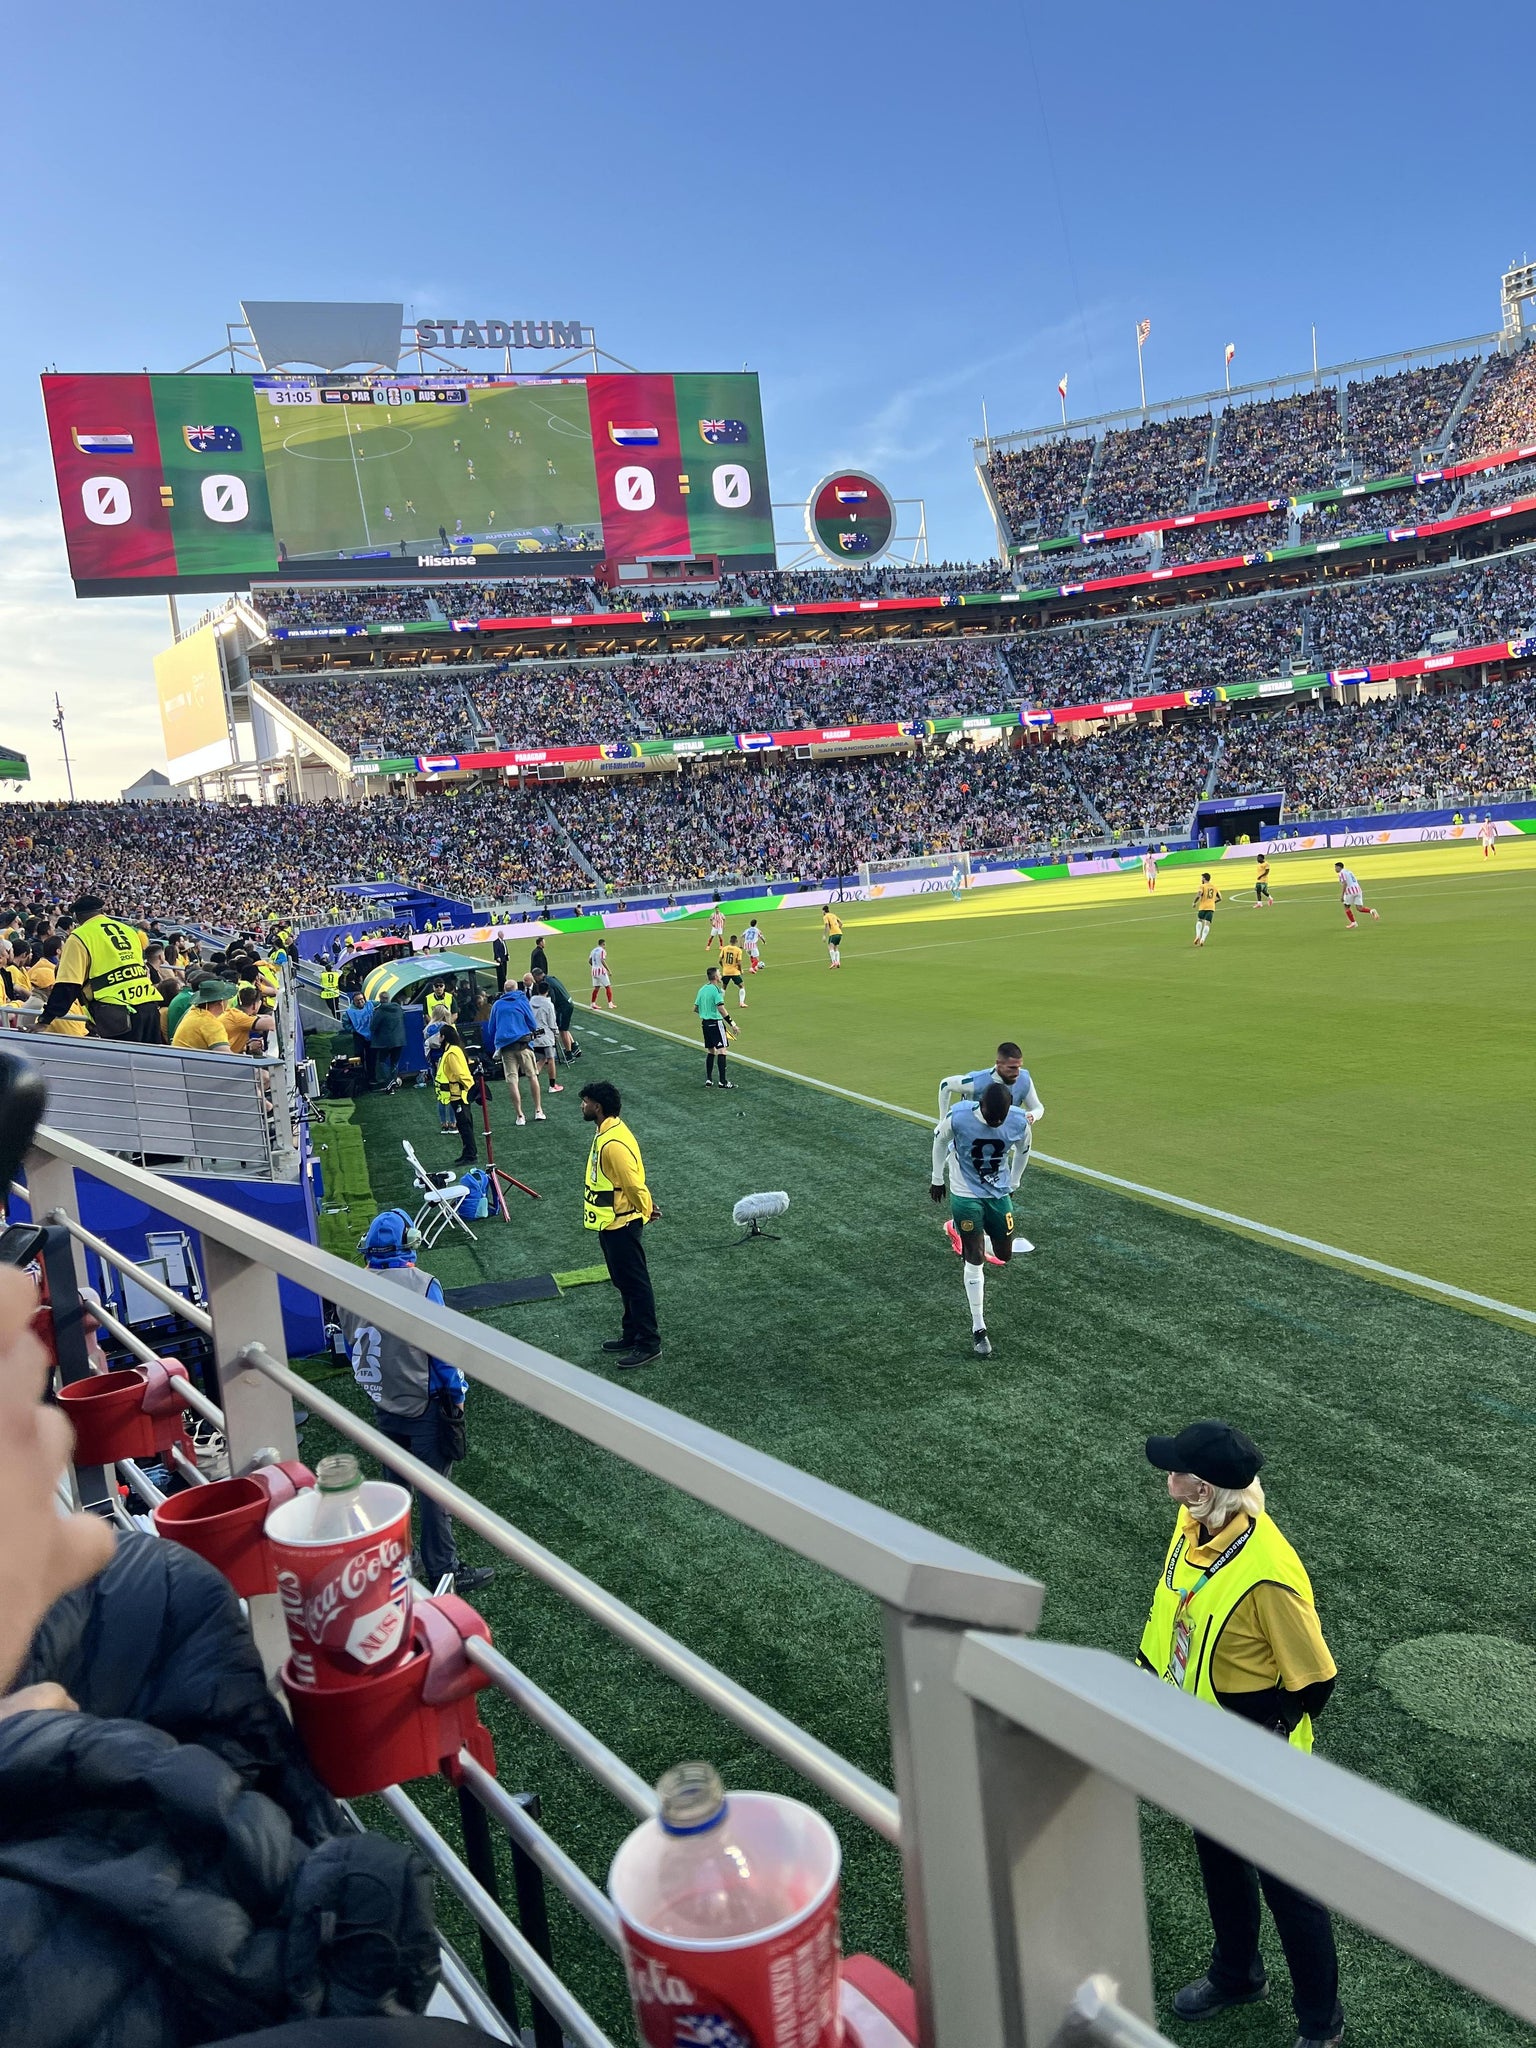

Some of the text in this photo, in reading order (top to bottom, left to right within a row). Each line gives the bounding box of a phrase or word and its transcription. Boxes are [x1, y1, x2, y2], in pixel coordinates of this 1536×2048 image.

[416, 319, 584, 349] STADIUM
[276, 391, 436, 403] 31:05 PAR 0 0 AUS
[614, 465, 656, 511] 0
[712, 464, 751, 509] 0
[81, 476, 132, 526] 0
[200, 474, 249, 523] 0
[485, 531, 533, 540] AUSTRALIA
[418, 555, 477, 568] Hisense
[1258, 680, 1293, 693] AUSTRALIA
[515, 752, 547, 762] PARAGUAY
[353, 763, 380, 773] STRALIA
[600, 760, 646, 771] #FIFAWorldCup
[1343, 832, 1374, 847] Dove
[1420, 827, 1447, 842] Dove
[1267, 839, 1296, 854] Dove
[1206, 888, 1214, 899] 13
[424, 932, 466, 949] Dove
[725, 951, 734, 965] 16
[117, 984, 156, 1001] 1501
[1005, 1212, 1014, 1230] 6
[1232, 1531, 1250, 1550] WORLD
[1224, 1547, 1234, 1559] CUP
